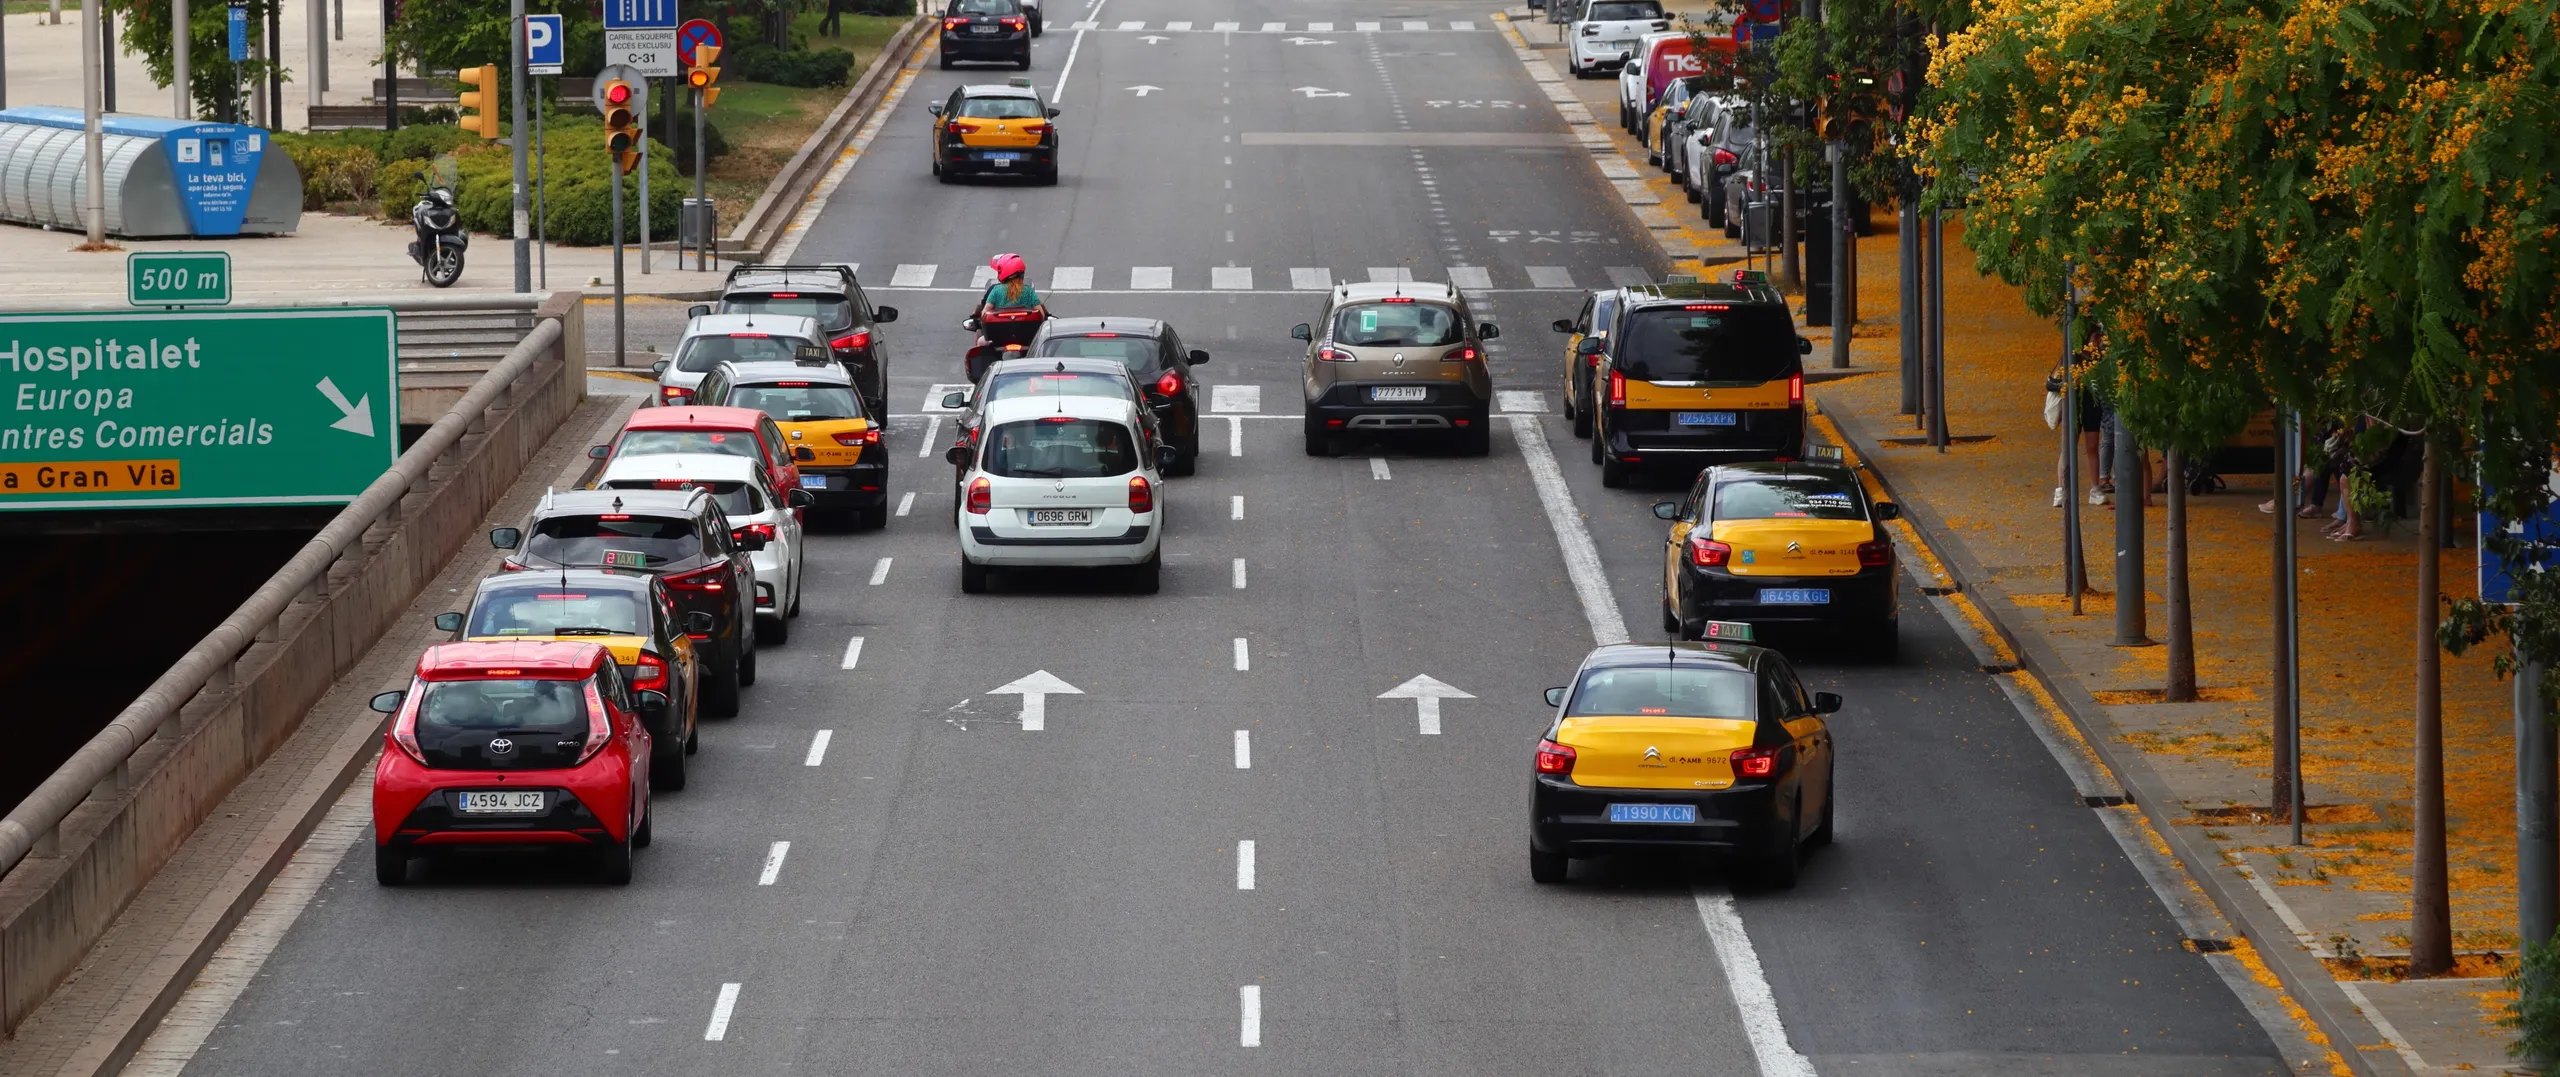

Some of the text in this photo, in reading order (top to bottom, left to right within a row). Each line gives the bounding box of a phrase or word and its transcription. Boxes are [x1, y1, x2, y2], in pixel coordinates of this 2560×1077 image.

[528, 22, 552, 60] P
[609, 33, 674, 42] CARRIL ESQUERRE
[628, 53, 656, 63] C-31
[188, 173, 247, 184] La teva bici,
[140, 268, 219, 291] 500 m
[1363, 315, 1375, 330] L
[0, 336, 201, 380] Hospitalet
[805, 347, 820, 357] TAXI
[1378, 387, 1423, 397] 7773 HVY
[16, 382, 134, 416] Europa
[1685, 414, 1734, 424] 7545 KPK
[95, 417, 274, 449] Comercials
[1817, 446, 1834, 458] TAXI
[36, 465, 109, 489] Gran
[127, 463, 176, 487] Via
[803, 475, 824, 486] KLG
[1037, 511, 1088, 522] 0696 GRM
[616, 553, 635, 565] TAXI
[1769, 591, 1827, 602] 6456 KGL
[1720, 624, 1740, 637] TAXI
[469, 793, 540, 807] 4594 JCZ
[1623, 806, 1692, 820] 1990 KCN
